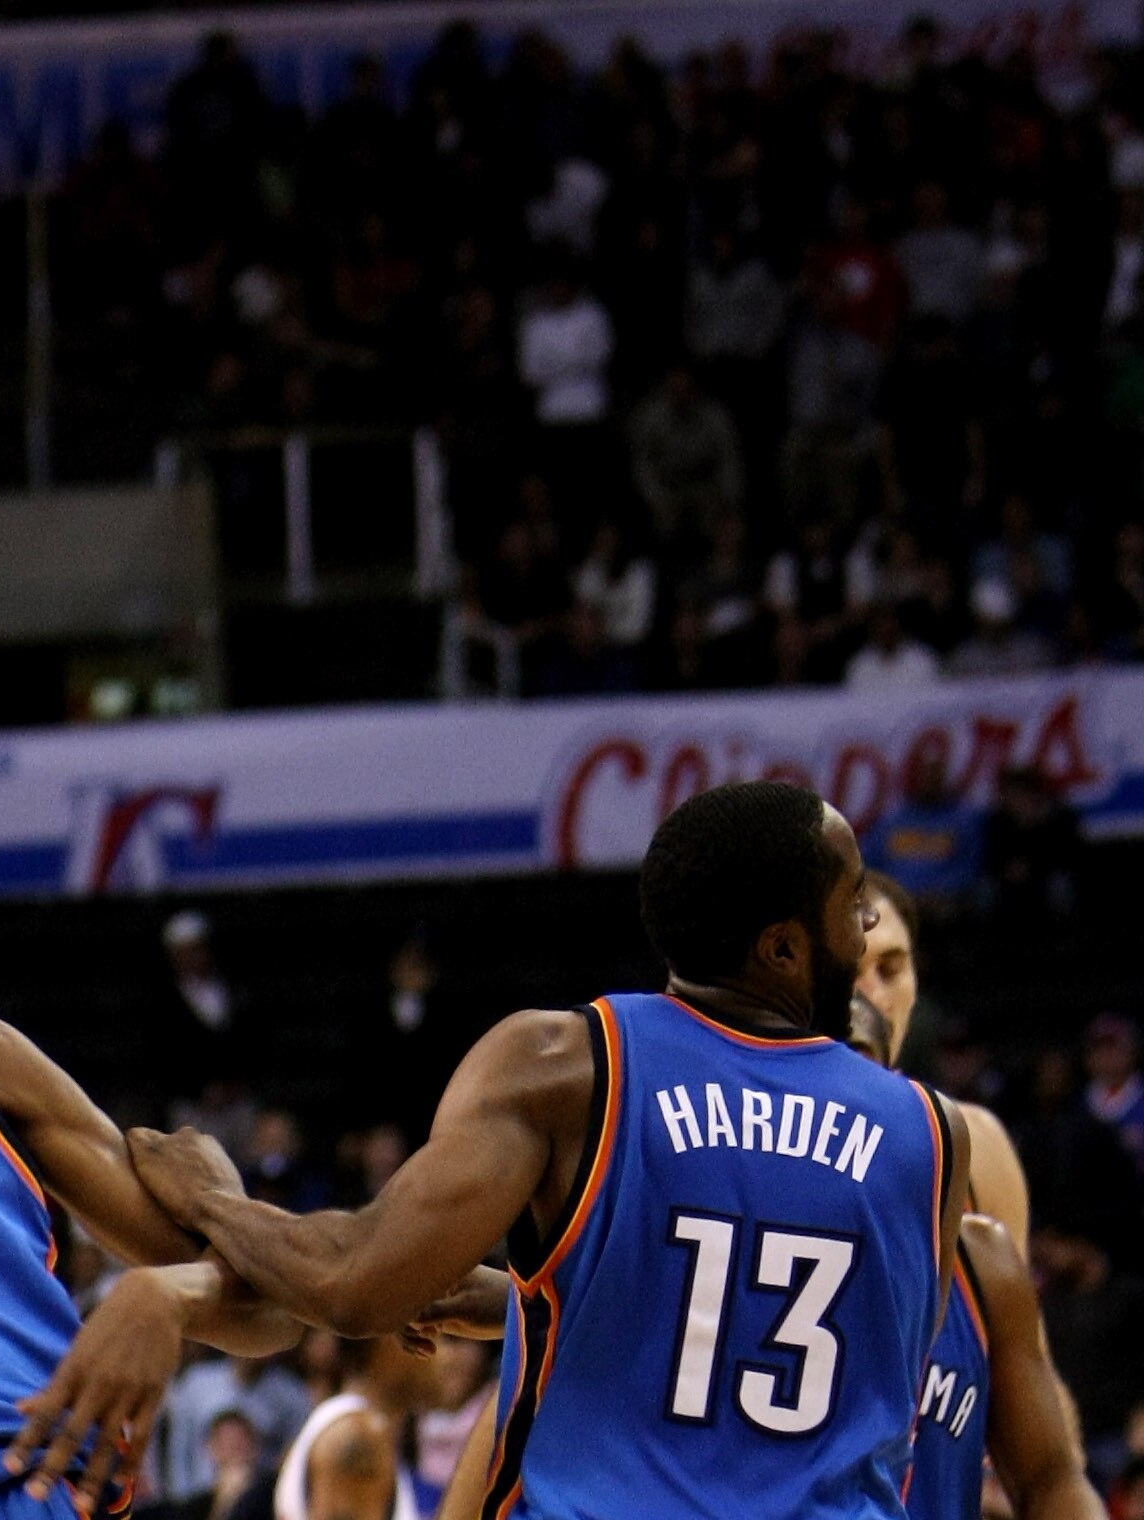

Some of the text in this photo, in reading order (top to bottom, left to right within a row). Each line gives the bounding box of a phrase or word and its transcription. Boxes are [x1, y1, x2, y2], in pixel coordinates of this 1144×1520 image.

[560, 696, 1099, 871] Cpers
[656, 1083, 884, 1183] HARDEN
[667, 1210, 858, 1437] 13
